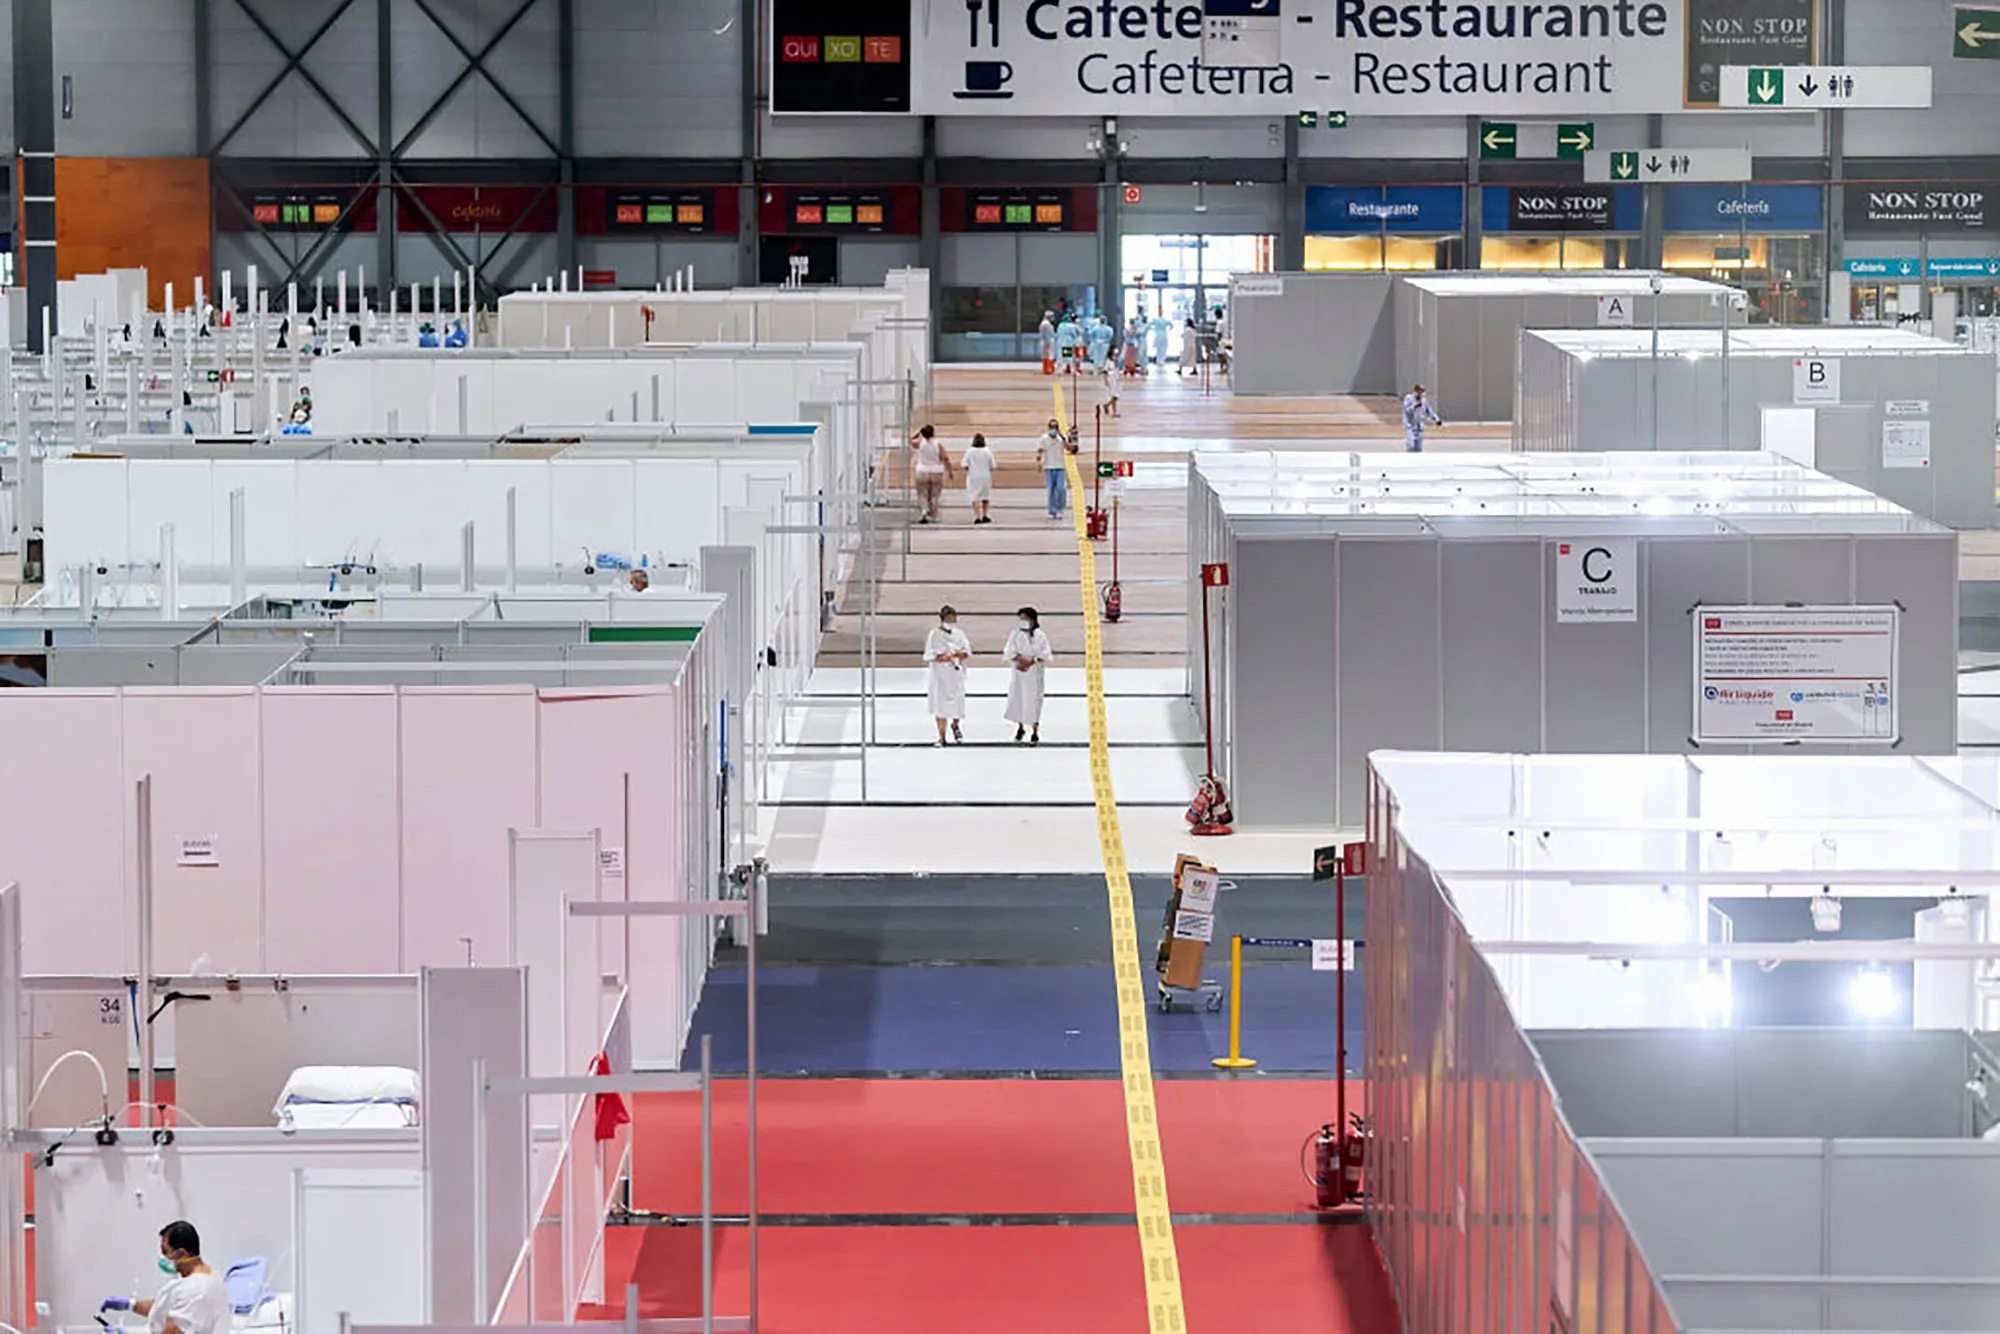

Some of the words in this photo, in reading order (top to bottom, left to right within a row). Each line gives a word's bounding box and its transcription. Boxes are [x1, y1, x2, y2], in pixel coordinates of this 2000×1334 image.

[1025, 0, 1202, 40] Cafete
[1335, 0, 1667, 40] Restaurante
[1700, 18, 1743, 35] NON
[1753, 18, 1808, 35] STOP
[785, 41, 817, 58] QUI
[829, 41, 856, 58] XO
[869, 41, 892, 58] TE
[1354, 52, 1614, 95] Restaurant
[1348, 202, 1420, 216] Restaurante
[1518, 197, 1557, 210] NON
[1562, 197, 1609, 210] STOP
[1867, 192, 1919, 209] NON
[1924, 192, 1985, 209] STOP
[1608, 297, 1624, 315] A
[1808, 361, 1826, 384] B
[1581, 547, 1613, 583] C
[100, 997, 121, 1013] 34
